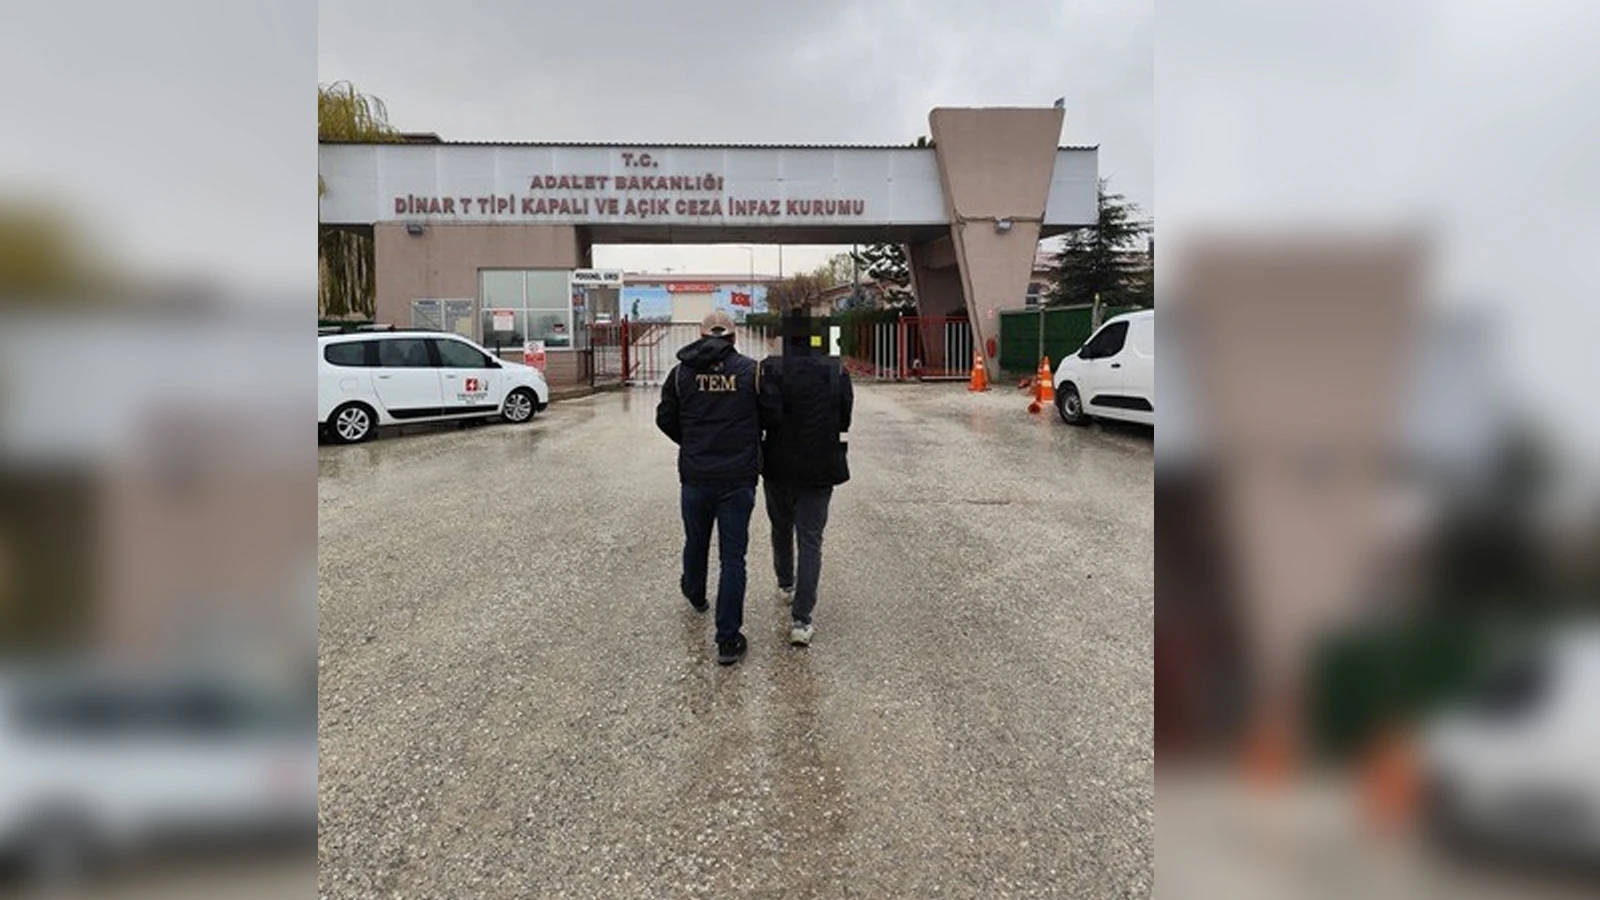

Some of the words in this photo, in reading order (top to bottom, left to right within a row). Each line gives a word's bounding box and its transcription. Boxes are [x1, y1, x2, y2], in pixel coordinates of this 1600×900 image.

[622, 153, 659, 168] T.C.
[530, 175, 608, 190] ADALET
[614, 174, 724, 191] BAKANLIĞI
[394, 194, 455, 214] DİNAR
[460, 198, 472, 214] T
[477, 194, 516, 214] TİPİ
[521, 198, 589, 214] KAPALI
[595, 198, 619, 214] VE
[624, 199, 670, 218] AÇIK
[675, 200, 723, 215] CEZA
[729, 197, 780, 216] İNFAZ
[786, 200, 865, 216] KURUMU
[695, 374, 737, 392] TEM
